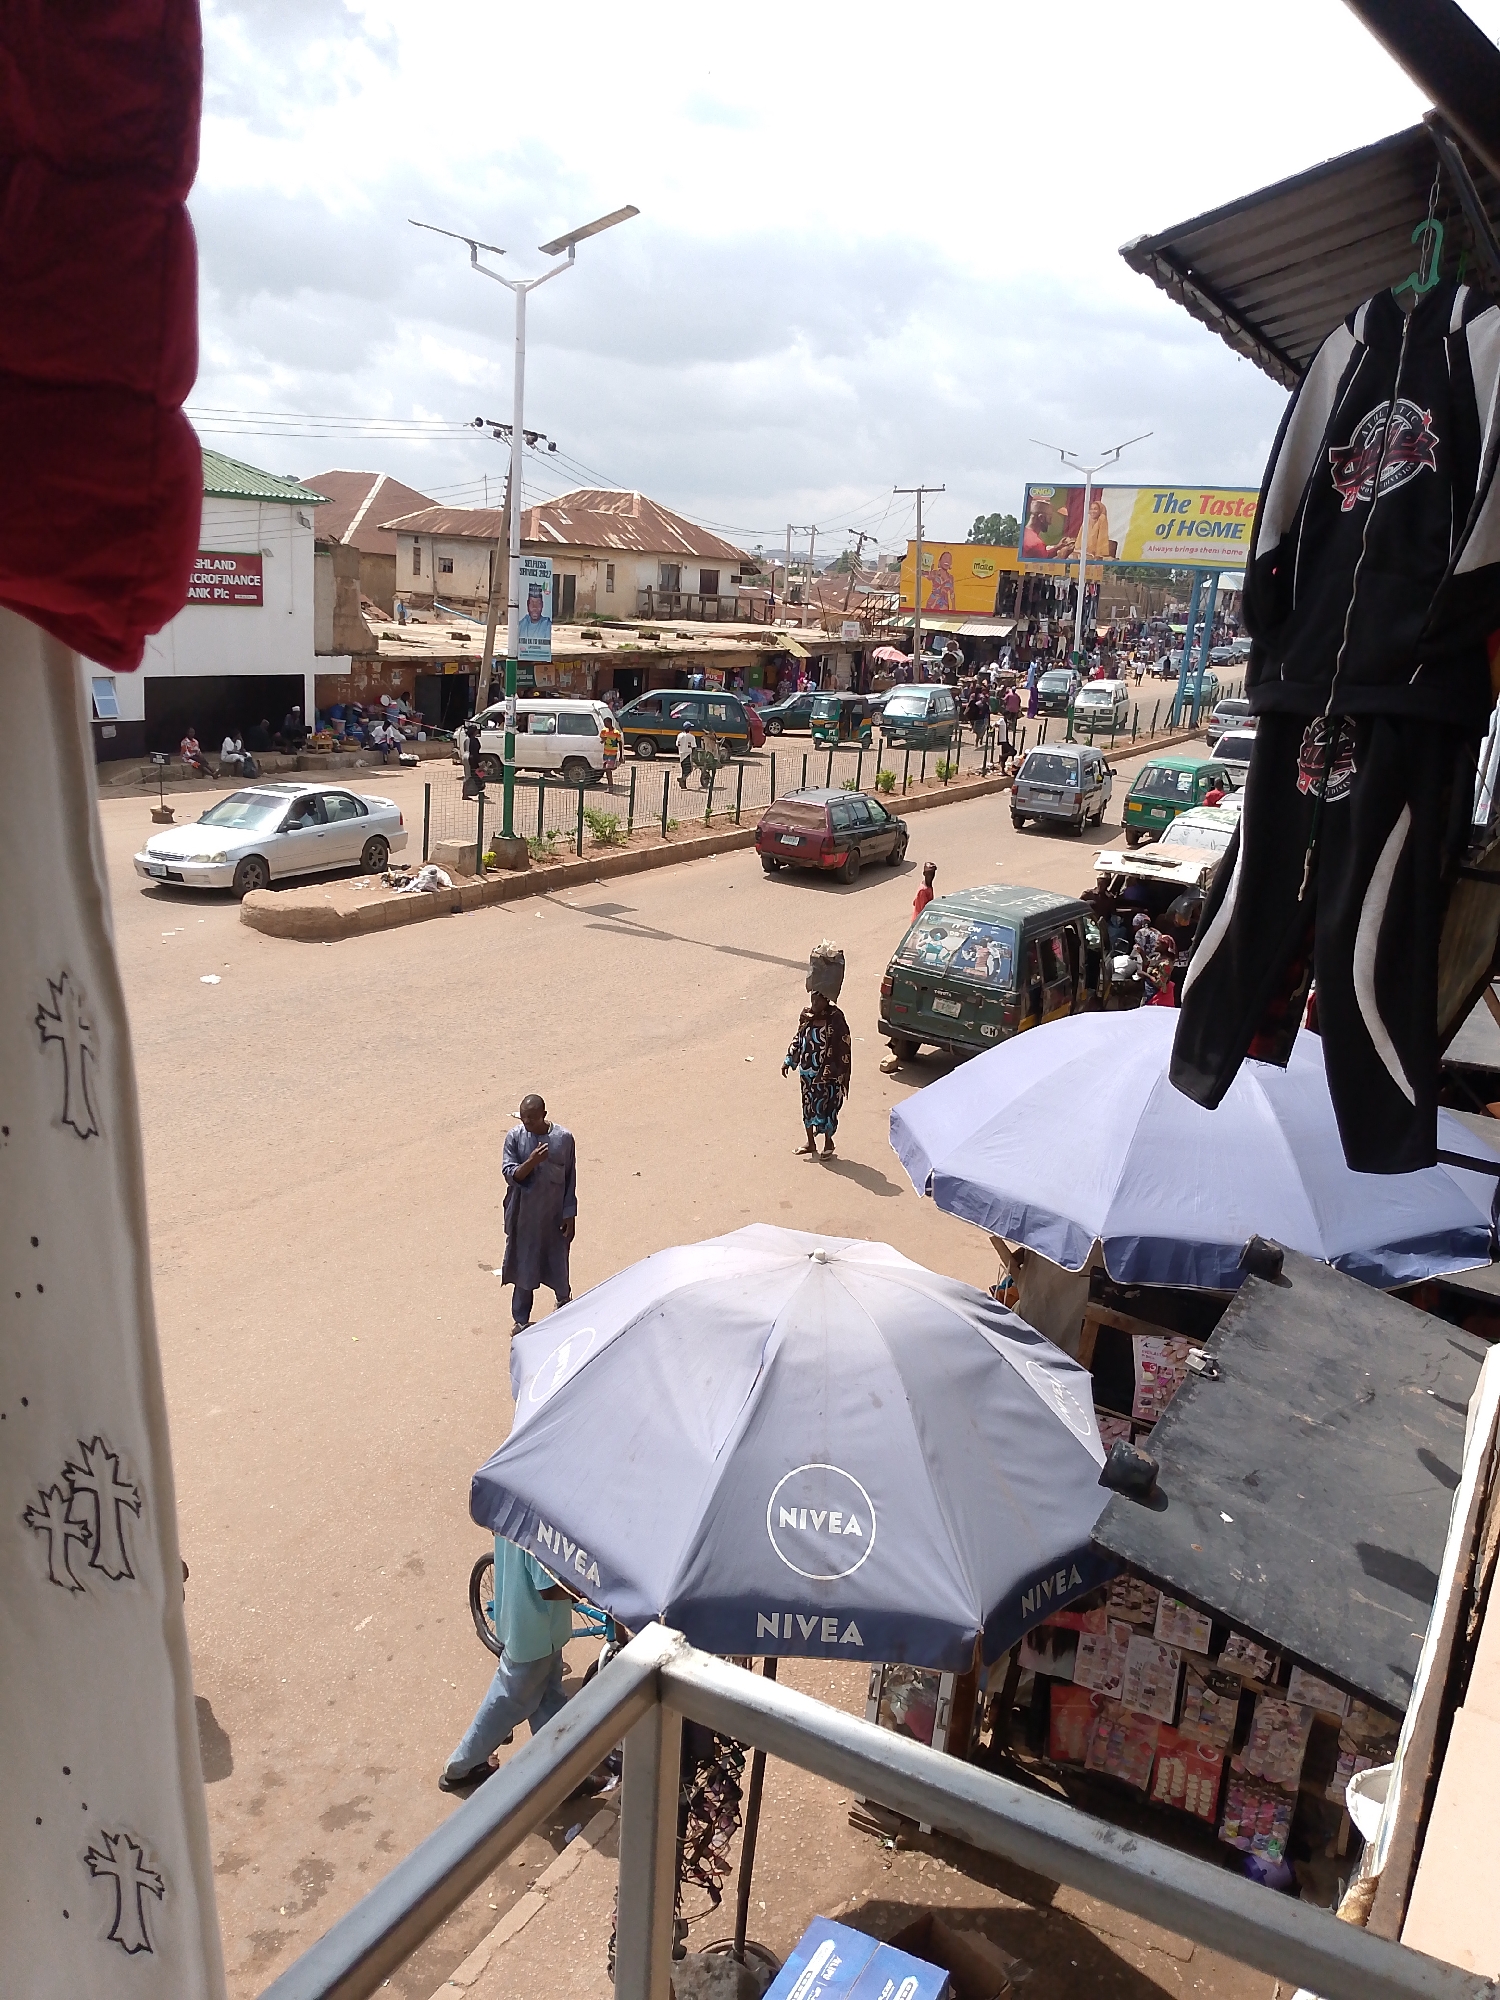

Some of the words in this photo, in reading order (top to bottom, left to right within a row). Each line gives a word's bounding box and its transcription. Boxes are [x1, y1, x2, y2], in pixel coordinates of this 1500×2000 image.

[1152, 492, 1192, 514] The
[1199, 494, 1258, 518] Taste
[1155, 518, 1176, 540] of
[1176, 520, 1246, 539] HOME
[1147, 545, 1173, 554] Always
[1175, 546, 1198, 554] brings
[1221, 548, 1243, 556] home
[779, 1506, 863, 1537] NIVEA
[537, 1519, 601, 1588] NIVEA
[1021, 1564, 1083, 1619] NIVEA
[756, 1612, 864, 1646] NIVEA
